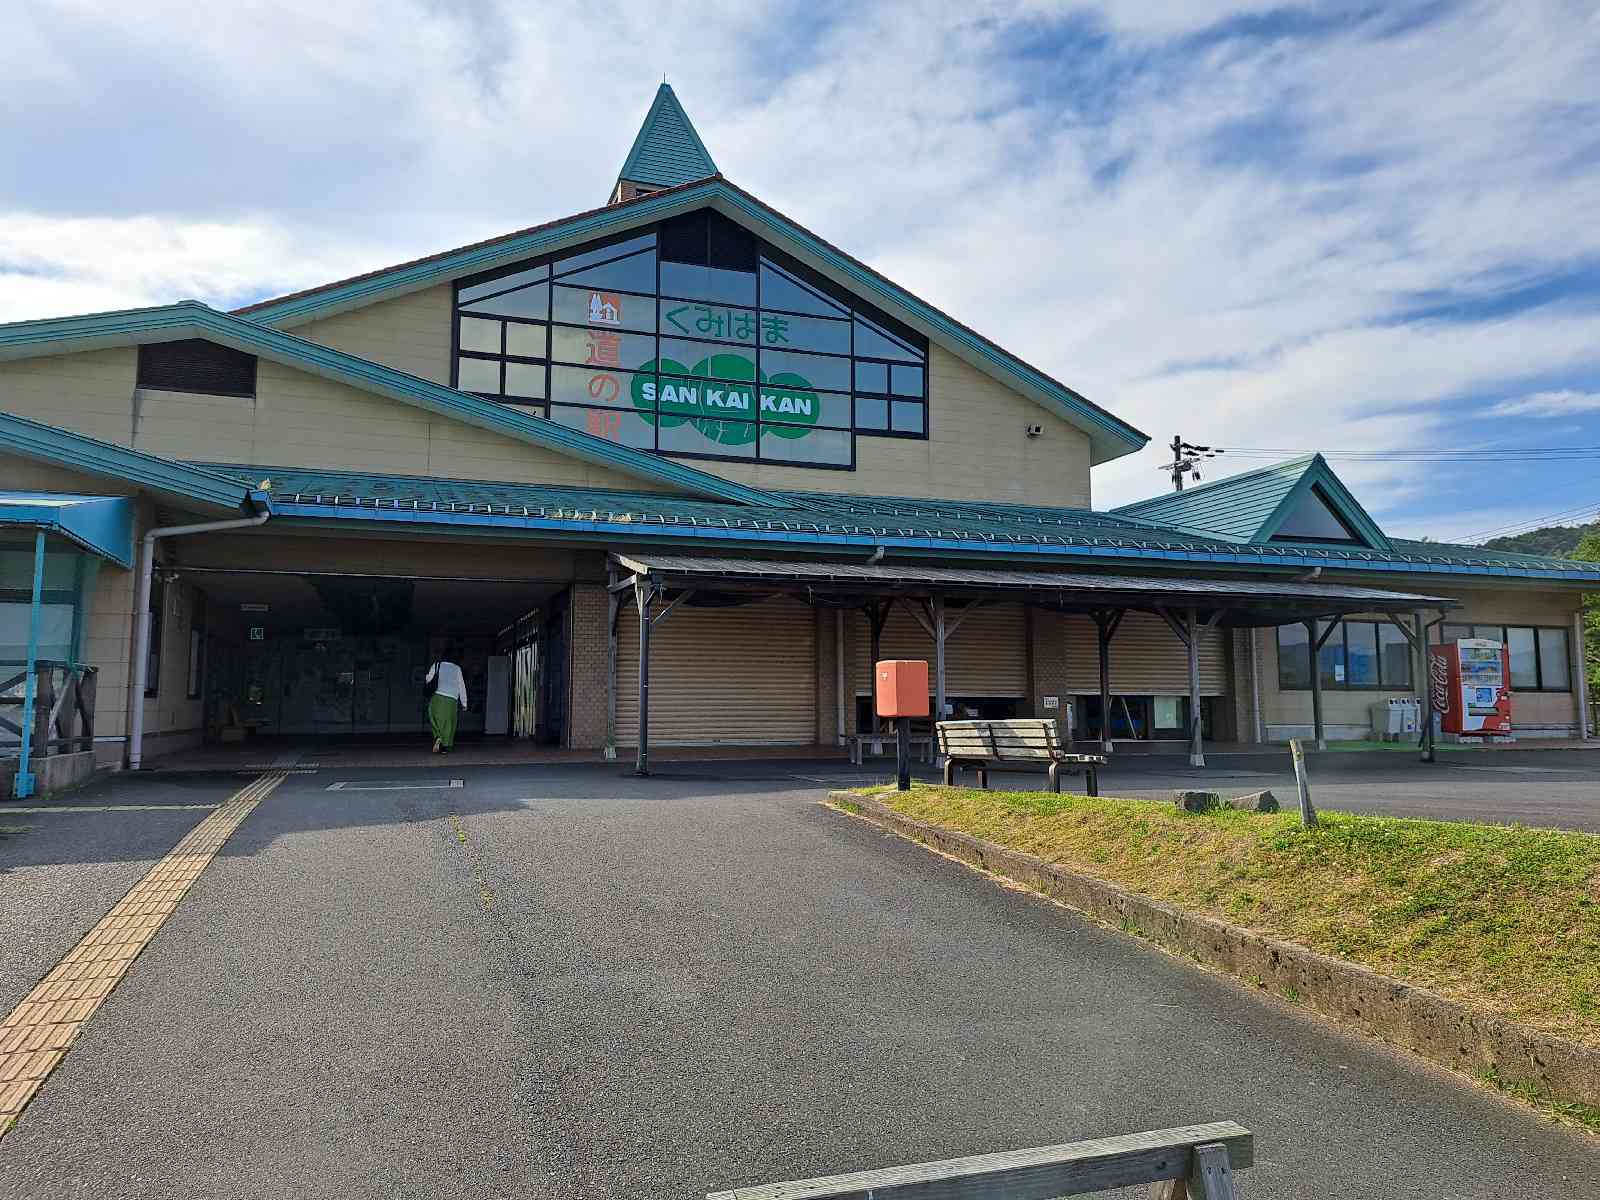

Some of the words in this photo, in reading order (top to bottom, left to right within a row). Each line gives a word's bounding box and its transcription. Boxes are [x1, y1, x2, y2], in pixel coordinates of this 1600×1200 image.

[666, 305, 789, 343] くみはま
[641, 382, 697, 405] SAN
[706, 389, 749, 410] KAI
[760, 394, 812, 416] KAN
